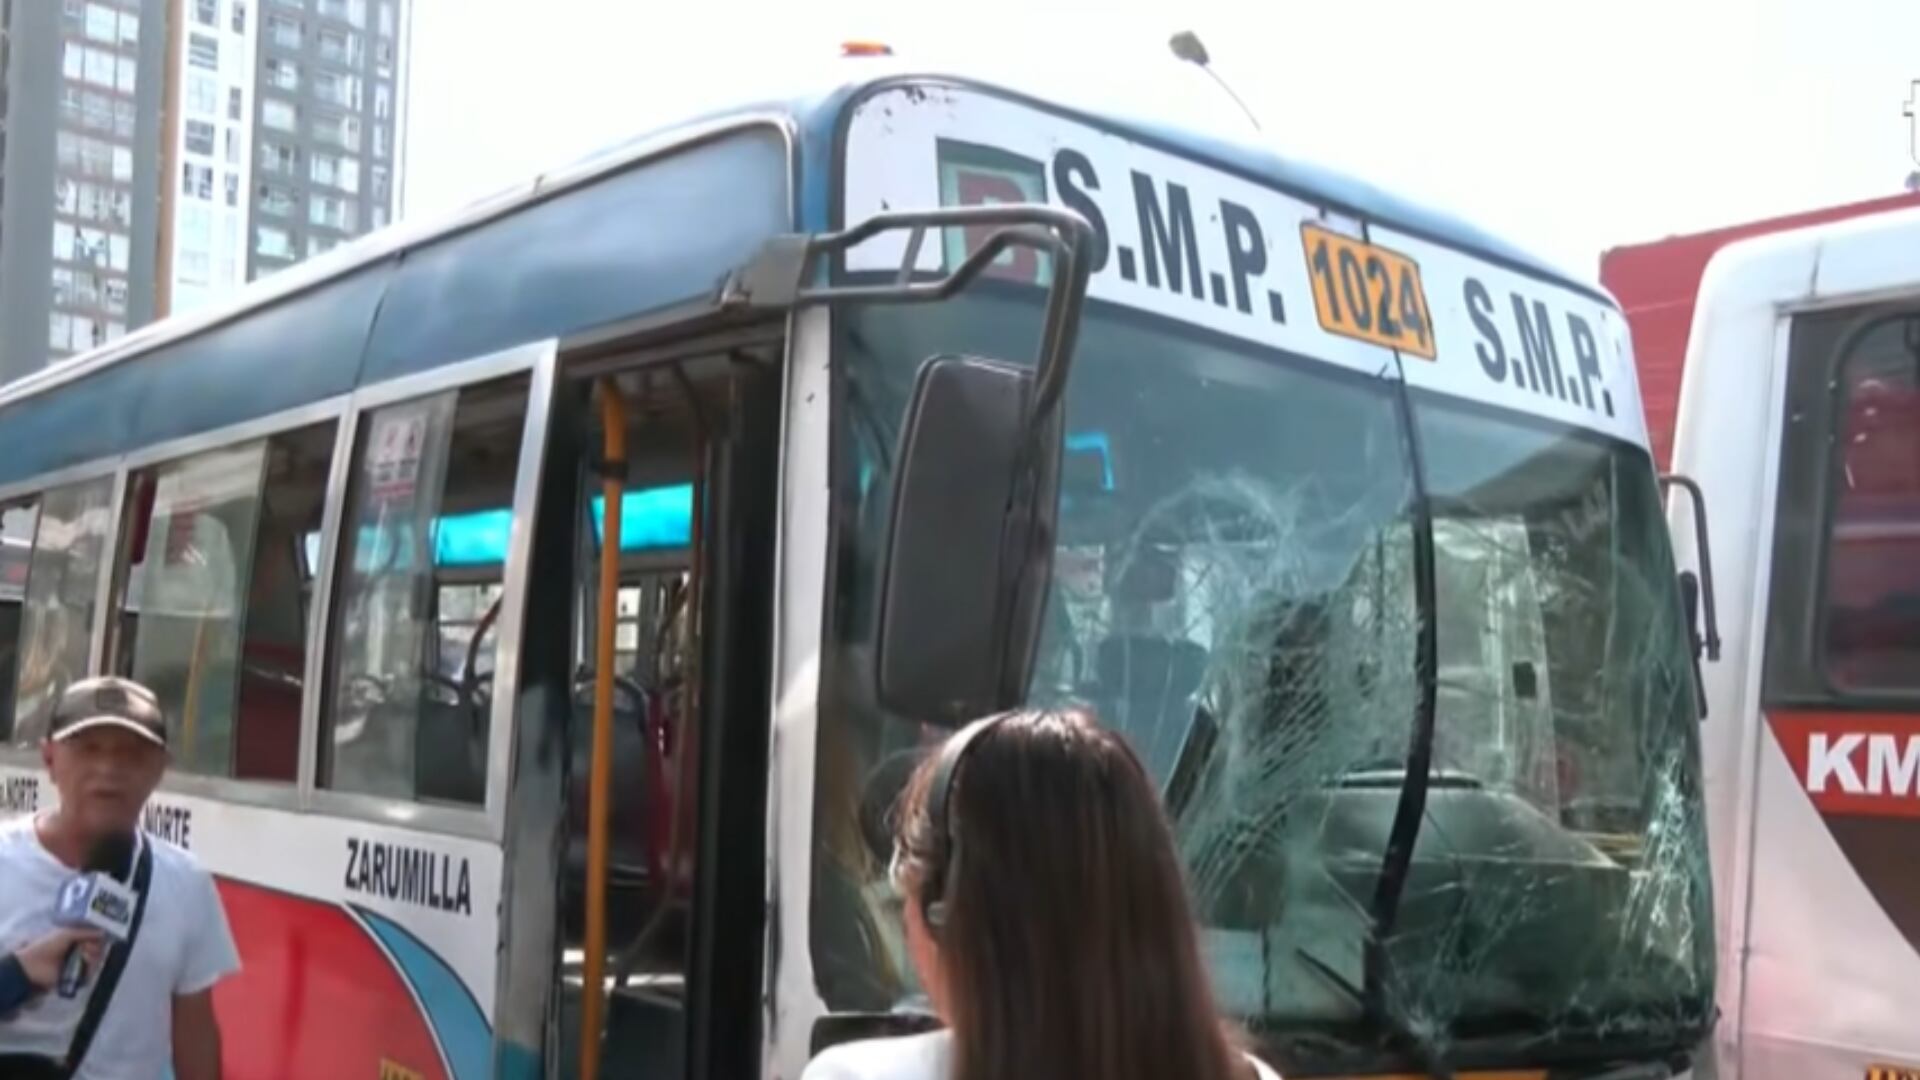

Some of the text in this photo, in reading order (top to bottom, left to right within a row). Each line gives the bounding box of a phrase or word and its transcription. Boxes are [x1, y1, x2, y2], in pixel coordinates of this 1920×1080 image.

[1053, 147, 1287, 324] S.M.P.
[1313, 239, 1426, 348] 1024
[1463, 277, 1615, 418] S.M.P.
[345, 838, 471, 917] ZARUMILLA
